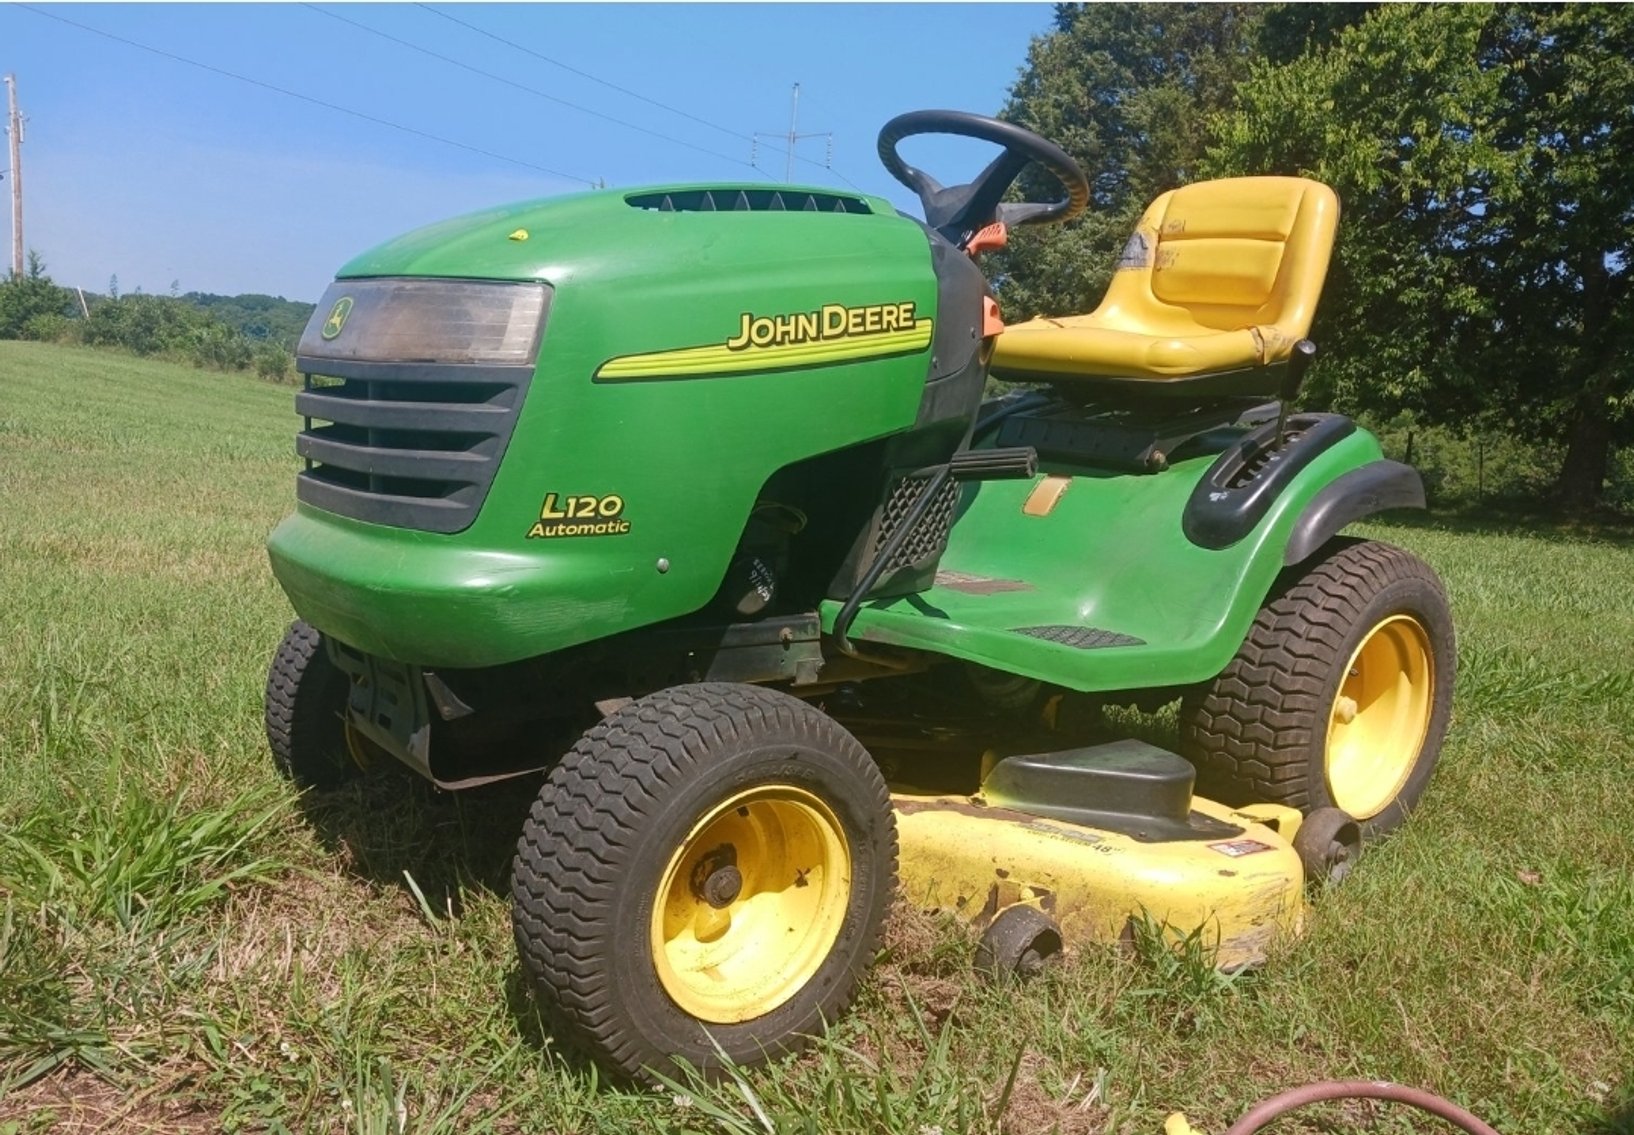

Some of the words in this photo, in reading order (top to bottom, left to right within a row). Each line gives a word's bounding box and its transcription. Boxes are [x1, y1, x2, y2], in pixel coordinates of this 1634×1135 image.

[727, 312, 818, 351] JOHN
[821, 302, 916, 339] DEERE
[541, 493, 624, 519] L120
[527, 520, 631, 538] Automatic
